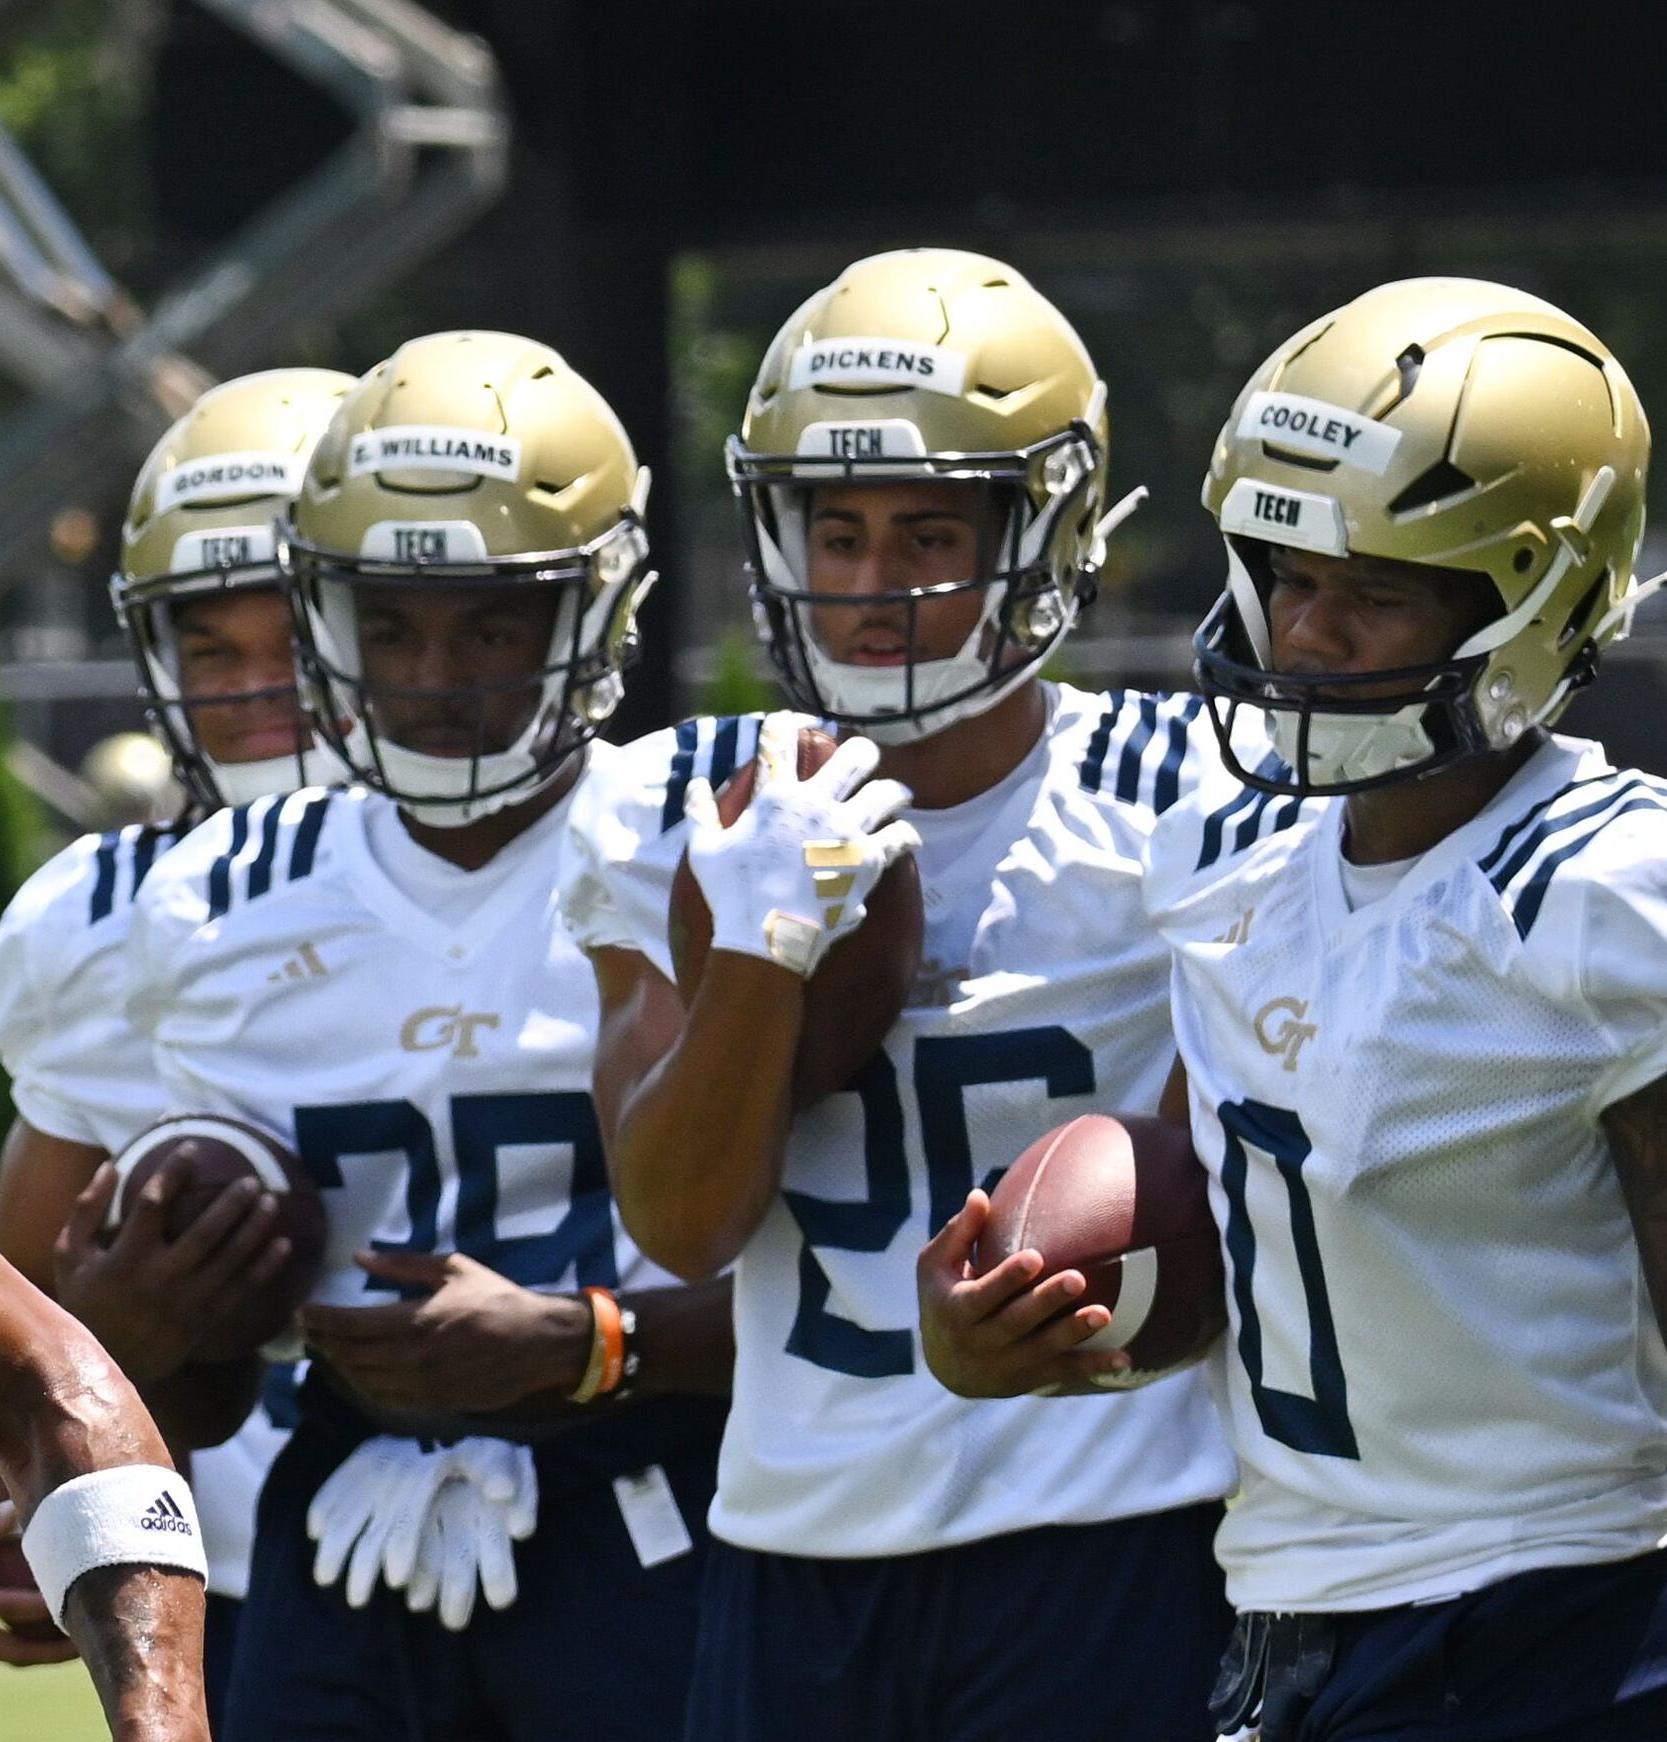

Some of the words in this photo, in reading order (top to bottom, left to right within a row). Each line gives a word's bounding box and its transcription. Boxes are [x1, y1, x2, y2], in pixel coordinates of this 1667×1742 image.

[810, 350, 935, 375] DICKENS
[829, 428, 883, 457] TECH
[1260, 404, 1363, 449] COOLEY
[381, 438, 514, 467] WILLIAMS
[175, 463, 286, 492] GORDON
[1254, 491, 1301, 527] TECH
[202, 536, 251, 567] TECH
[394, 529, 447, 562] TECH
[400, 1003, 501, 1058] GT
[1253, 996, 1317, 1072] GT
[1217, 1097, 1360, 1460] 0
[140, 1513, 192, 1536] adidas
